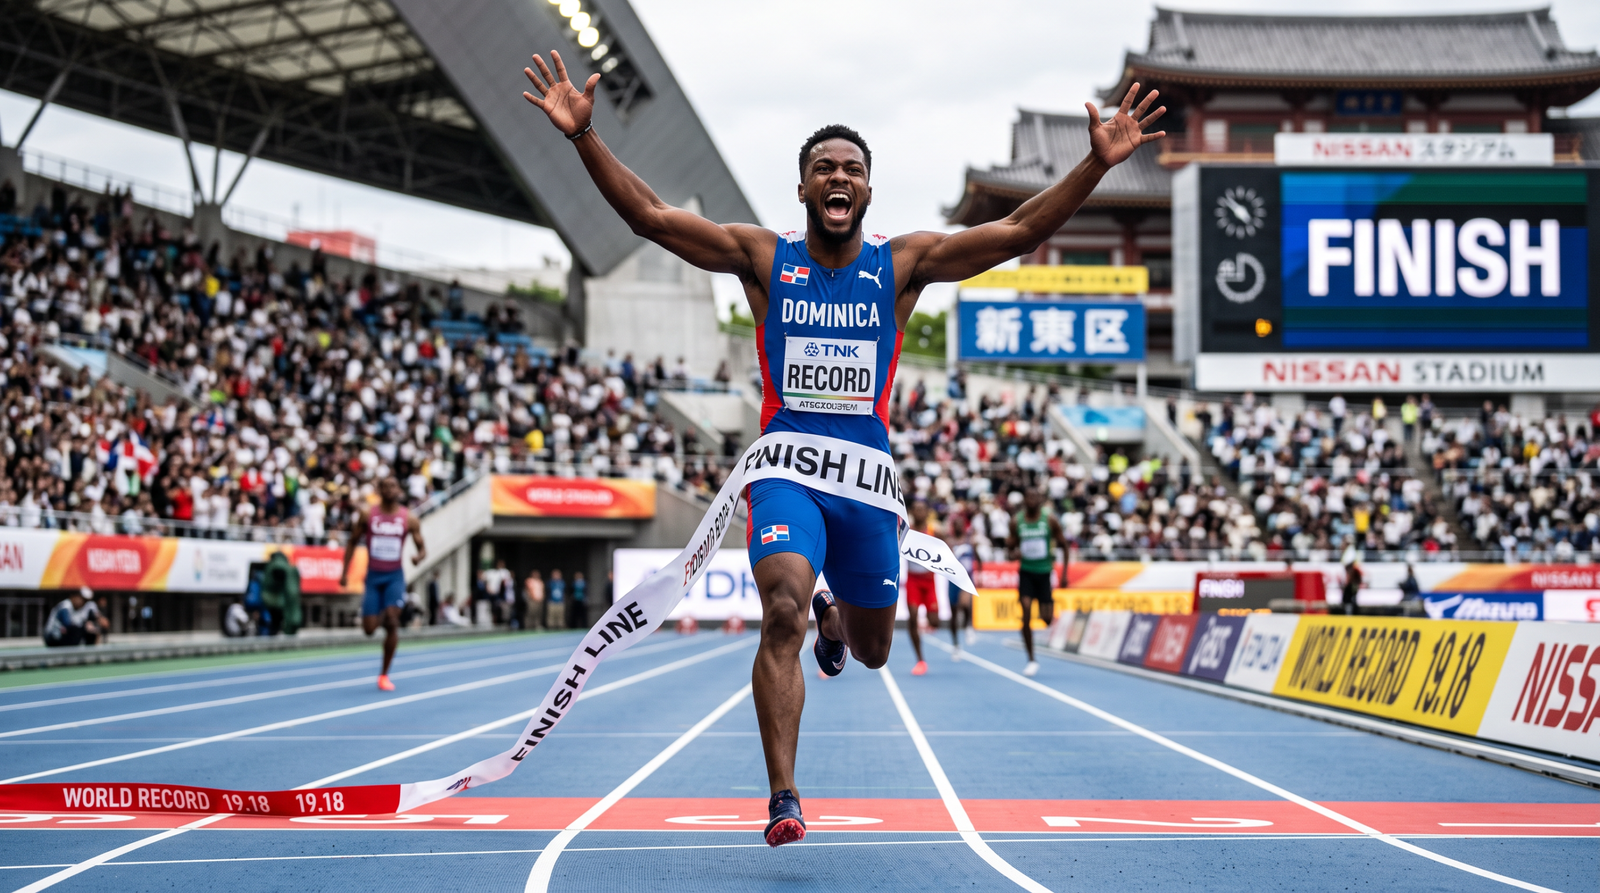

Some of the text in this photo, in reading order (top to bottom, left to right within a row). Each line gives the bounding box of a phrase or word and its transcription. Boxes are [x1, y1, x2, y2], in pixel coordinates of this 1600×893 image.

[1313, 139, 1414, 159] NISSAN
[1307, 218, 1562, 297] FINISH
[782, 298, 881, 328] DOMINICA
[975, 306, 1130, 354] 新東区
[821, 344, 860, 358] TNK
[787, 364, 871, 393] RECORD
[1263, 361, 1545, 383] NISSAN STADIUM
[511, 601, 648, 762] FINISH LINE
[1287, 624, 1352, 693] WORLD
[1336, 626, 1421, 705] RECORD
[1413, 630, 1486, 719] 19.18
[63, 787, 345, 813] WORLD RECORD 19.18 19.18
